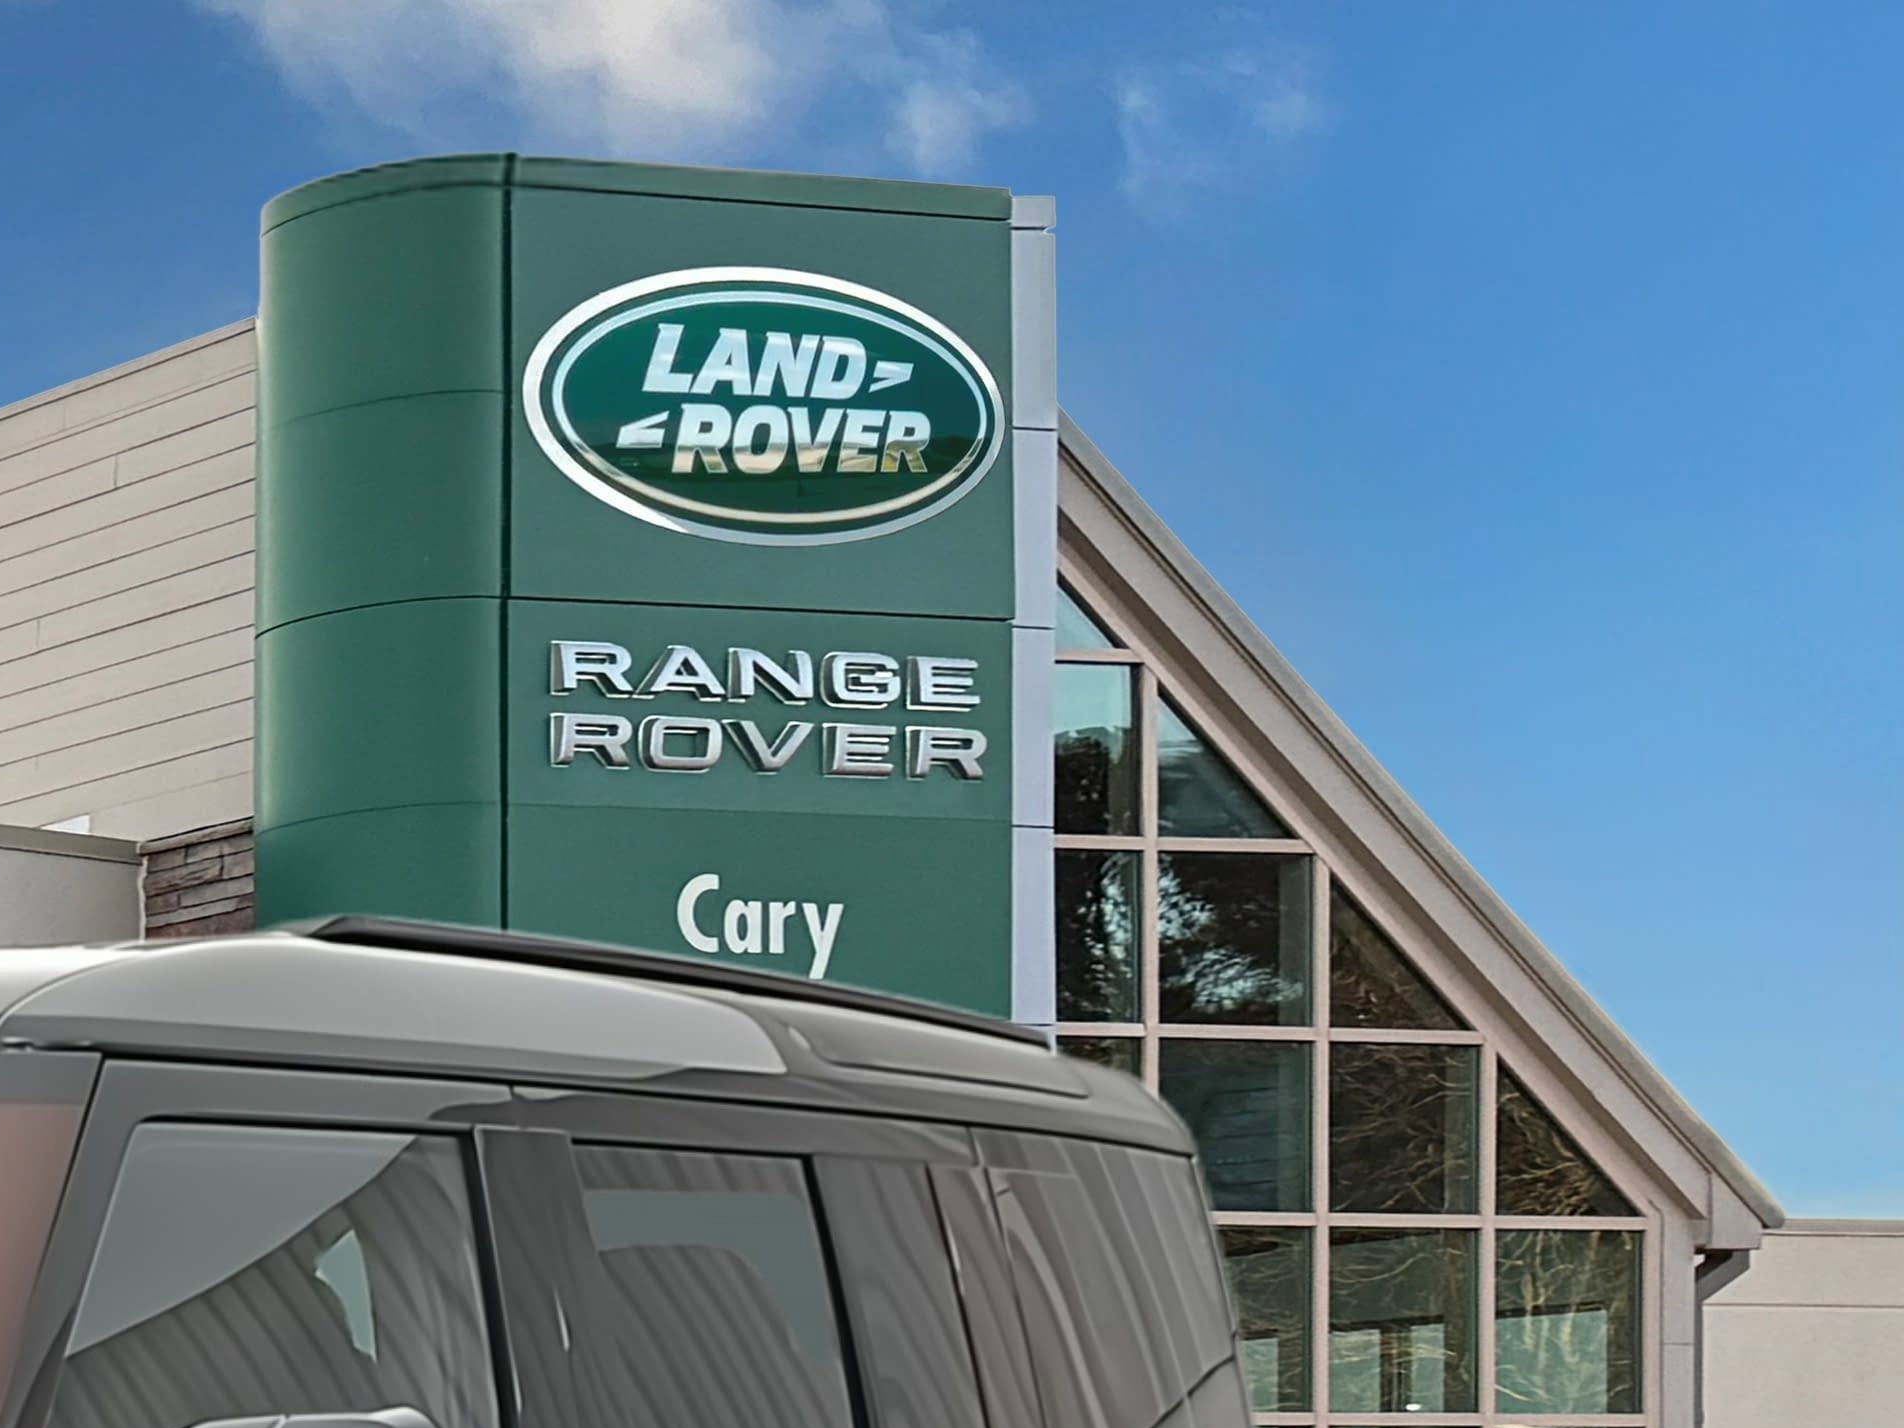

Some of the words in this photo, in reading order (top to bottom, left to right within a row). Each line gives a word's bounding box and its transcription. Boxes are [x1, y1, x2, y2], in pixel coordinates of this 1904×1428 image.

[641, 323, 868, 399] LAND
[671, 403, 932, 475] ROVER
[550, 640, 981, 712] RANGE
[550, 712, 988, 781] ROVER
[676, 873, 844, 980] Cary
